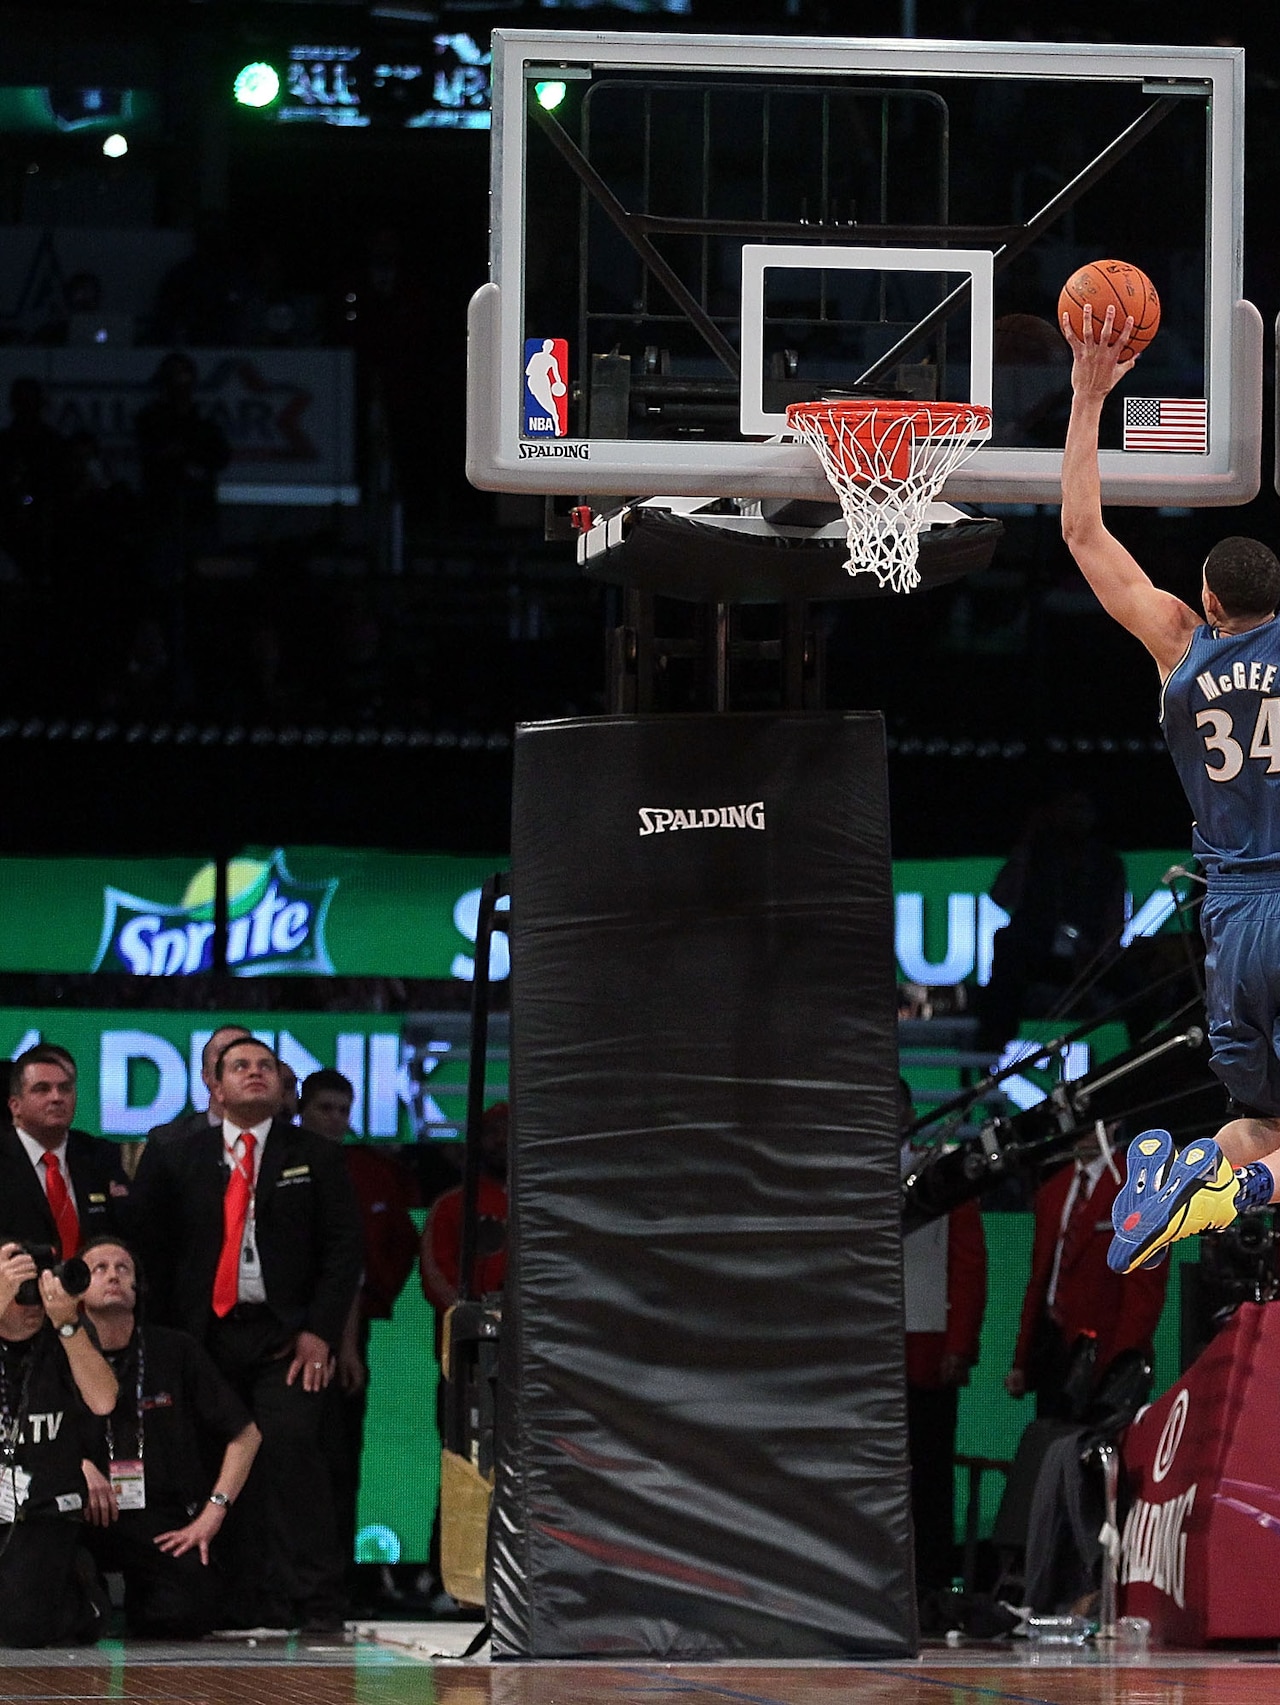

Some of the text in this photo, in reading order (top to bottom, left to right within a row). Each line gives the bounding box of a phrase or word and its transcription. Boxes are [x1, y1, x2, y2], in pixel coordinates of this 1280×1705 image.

[529, 417, 554, 431] NBA
[519, 443, 590, 460] SPALDING
[1196, 661, 1278, 702] McGEE
[638, 801, 766, 836] SPALDING
[28, 1411, 64, 1444] TV
